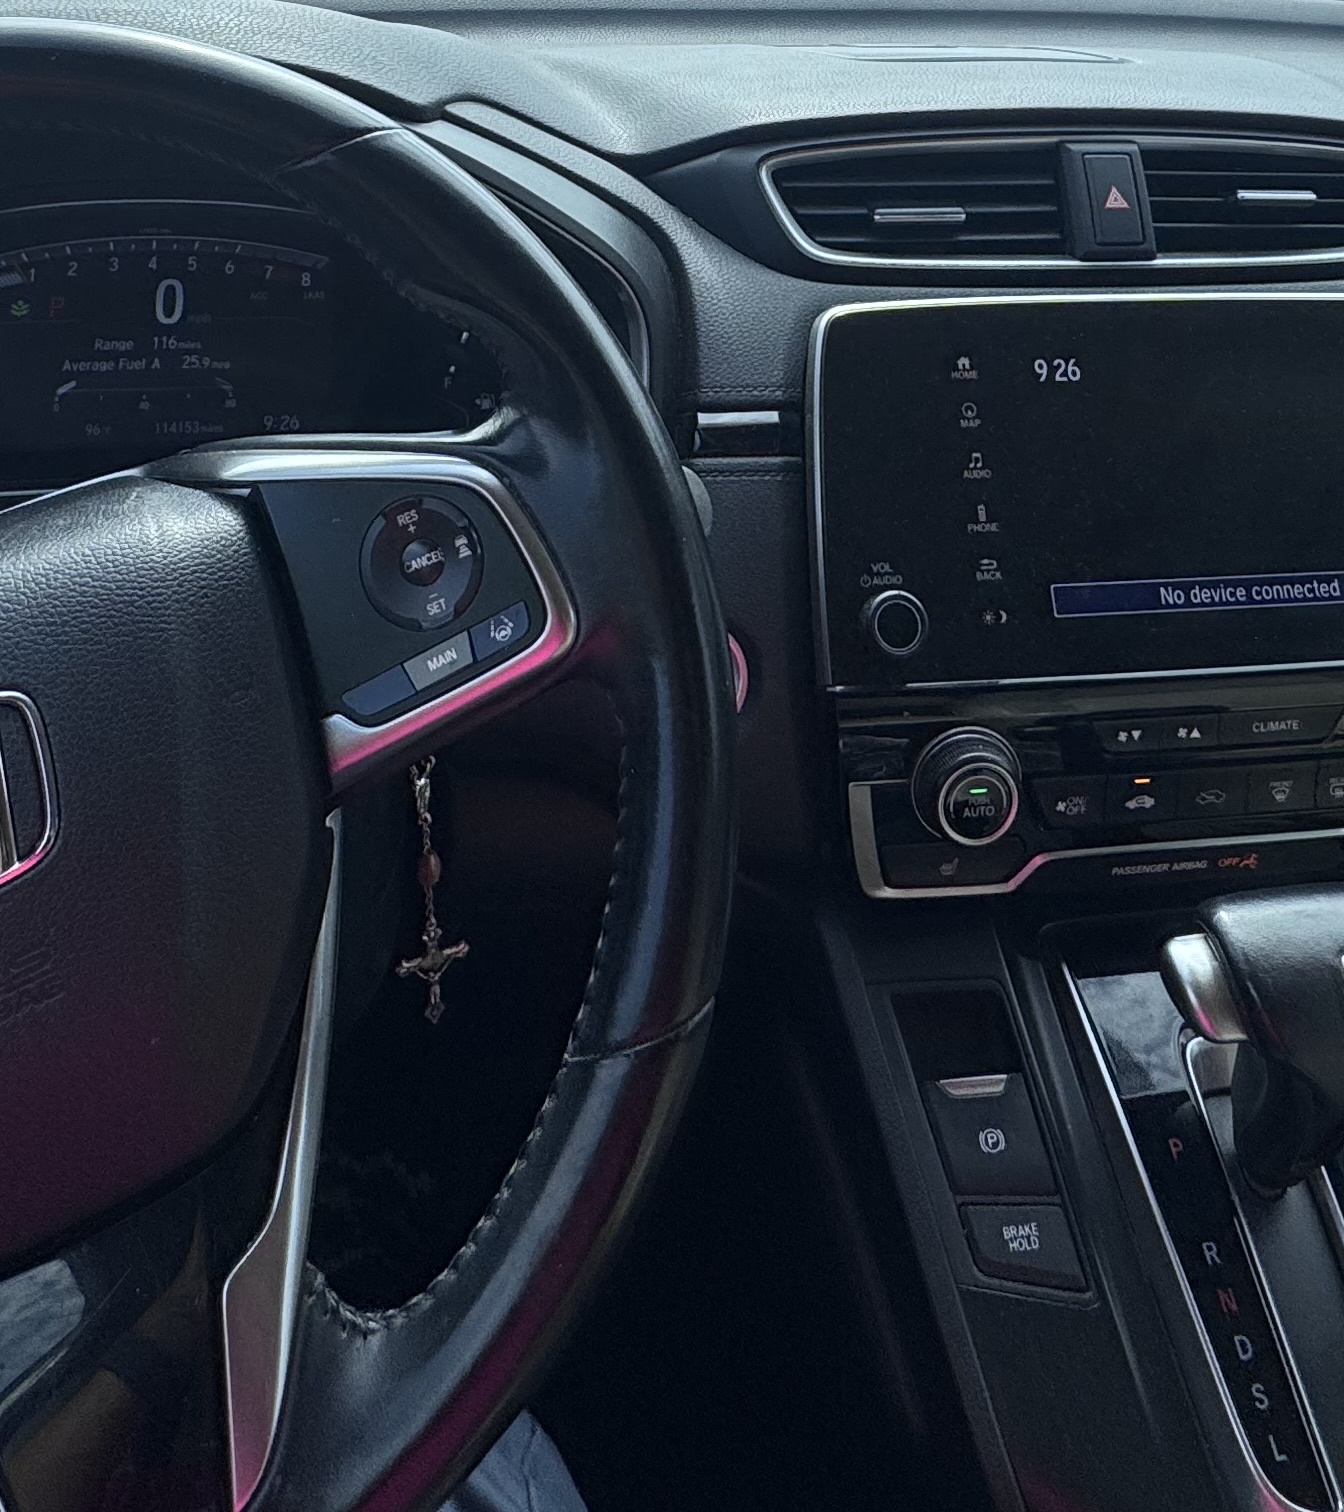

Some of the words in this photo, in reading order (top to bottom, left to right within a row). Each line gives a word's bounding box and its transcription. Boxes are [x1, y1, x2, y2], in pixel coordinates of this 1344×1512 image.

[67, 262, 78, 277] 2
[109, 257, 120, 272] 3
[147, 256, 157, 271] 4
[187, 256, 197, 271] 5
[224, 260, 235, 274] 6
[29, 268, 36, 283] 1
[264, 265, 274, 280] 7
[301, 272, 311, 287] 8
[155, 278, 184, 326] 0
[94, 338, 134, 353] Range
[152, 336, 177, 350] 116
[62, 359, 115, 374] Average
[119, 357, 146, 371] Fuel
[151, 358, 161, 370] A
[181, 354, 211, 369] 25.9
[951, 370, 978, 379] HOME
[444, 376, 453, 390] F
[155, 421, 200, 435] 114153
[263, 415, 300, 432] 9:26
[960, 418, 982, 428] MAP
[963, 469, 992, 479] AUDIO
[396, 509, 420, 527] RES
[967, 523, 1000, 533] PHONE
[403, 547, 445, 574] CANCEL
[871, 562, 894, 572] VOL
[872, 574, 903, 585] AUDIO
[975, 571, 1003, 581] BACK
[1159, 586, 1185, 606] No
[1189, 582, 1247, 605] device
[1250, 578, 1341, 601] connected
[425, 598, 447, 616] SET
[426, 648, 458, 672] MAIN
[1252, 719, 1301, 733] CLIMATE
[962, 806, 996, 818] AUTO
[1111, 861, 1171, 877] PASSENGER
[1171, 859, 1209, 872] AIRBAG
[1217, 856, 1240, 867] OFF
[1002, 1222, 1039, 1240] BRAKE
[1008, 1236, 1040, 1253] HOLD
[1201, 1241, 1223, 1266] R
[1233, 1335, 1253, 1362] D
[1250, 1382, 1269, 1409] S
[1267, 1434, 1289, 1462] L
